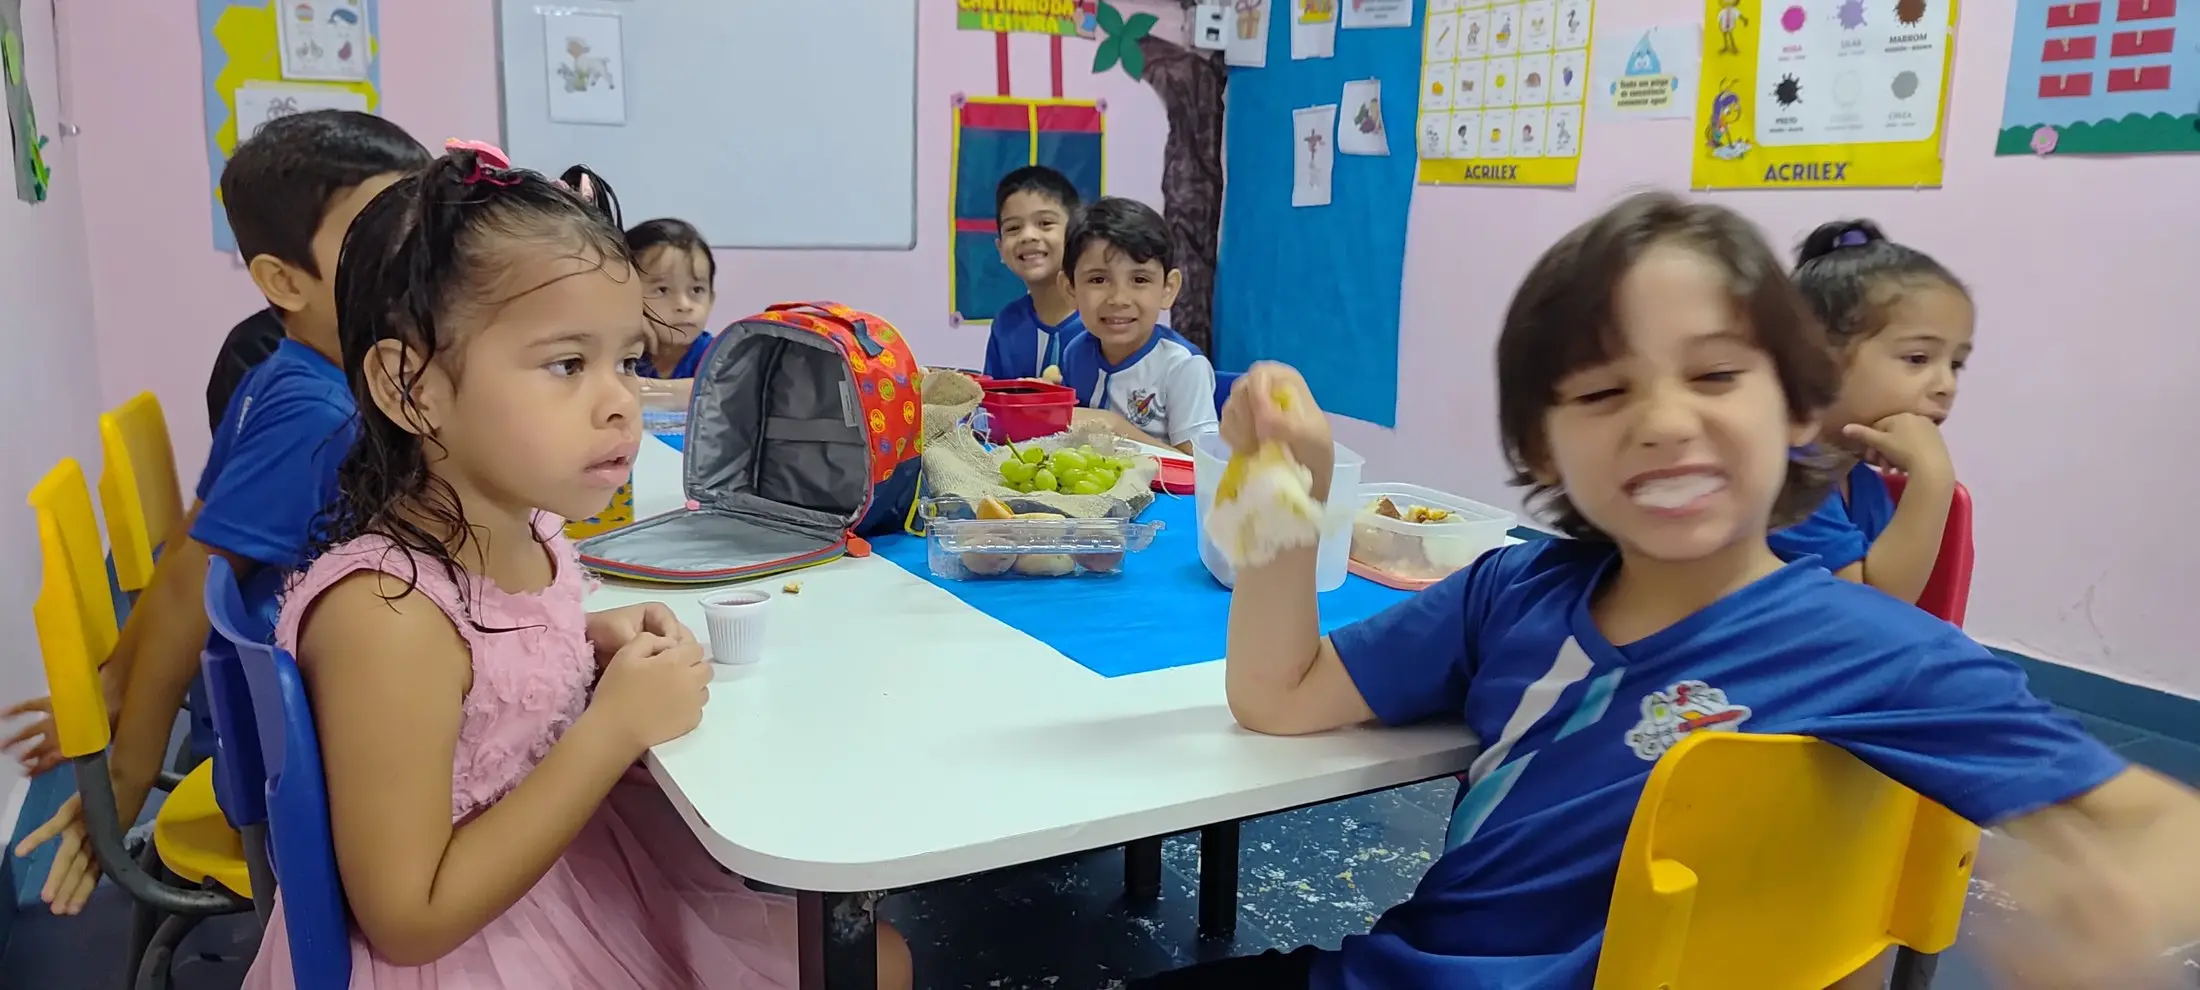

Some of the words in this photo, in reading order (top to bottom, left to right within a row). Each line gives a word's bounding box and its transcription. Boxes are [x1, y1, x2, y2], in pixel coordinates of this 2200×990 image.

[981, 12, 1058, 34] LEITURA
[1888, 33, 1928, 44] MARROM
[1775, 117, 1797, 125] PRETO
[1464, 164, 1517, 181] ACRILEX
[1763, 162, 1848, 182] ACRILEX
